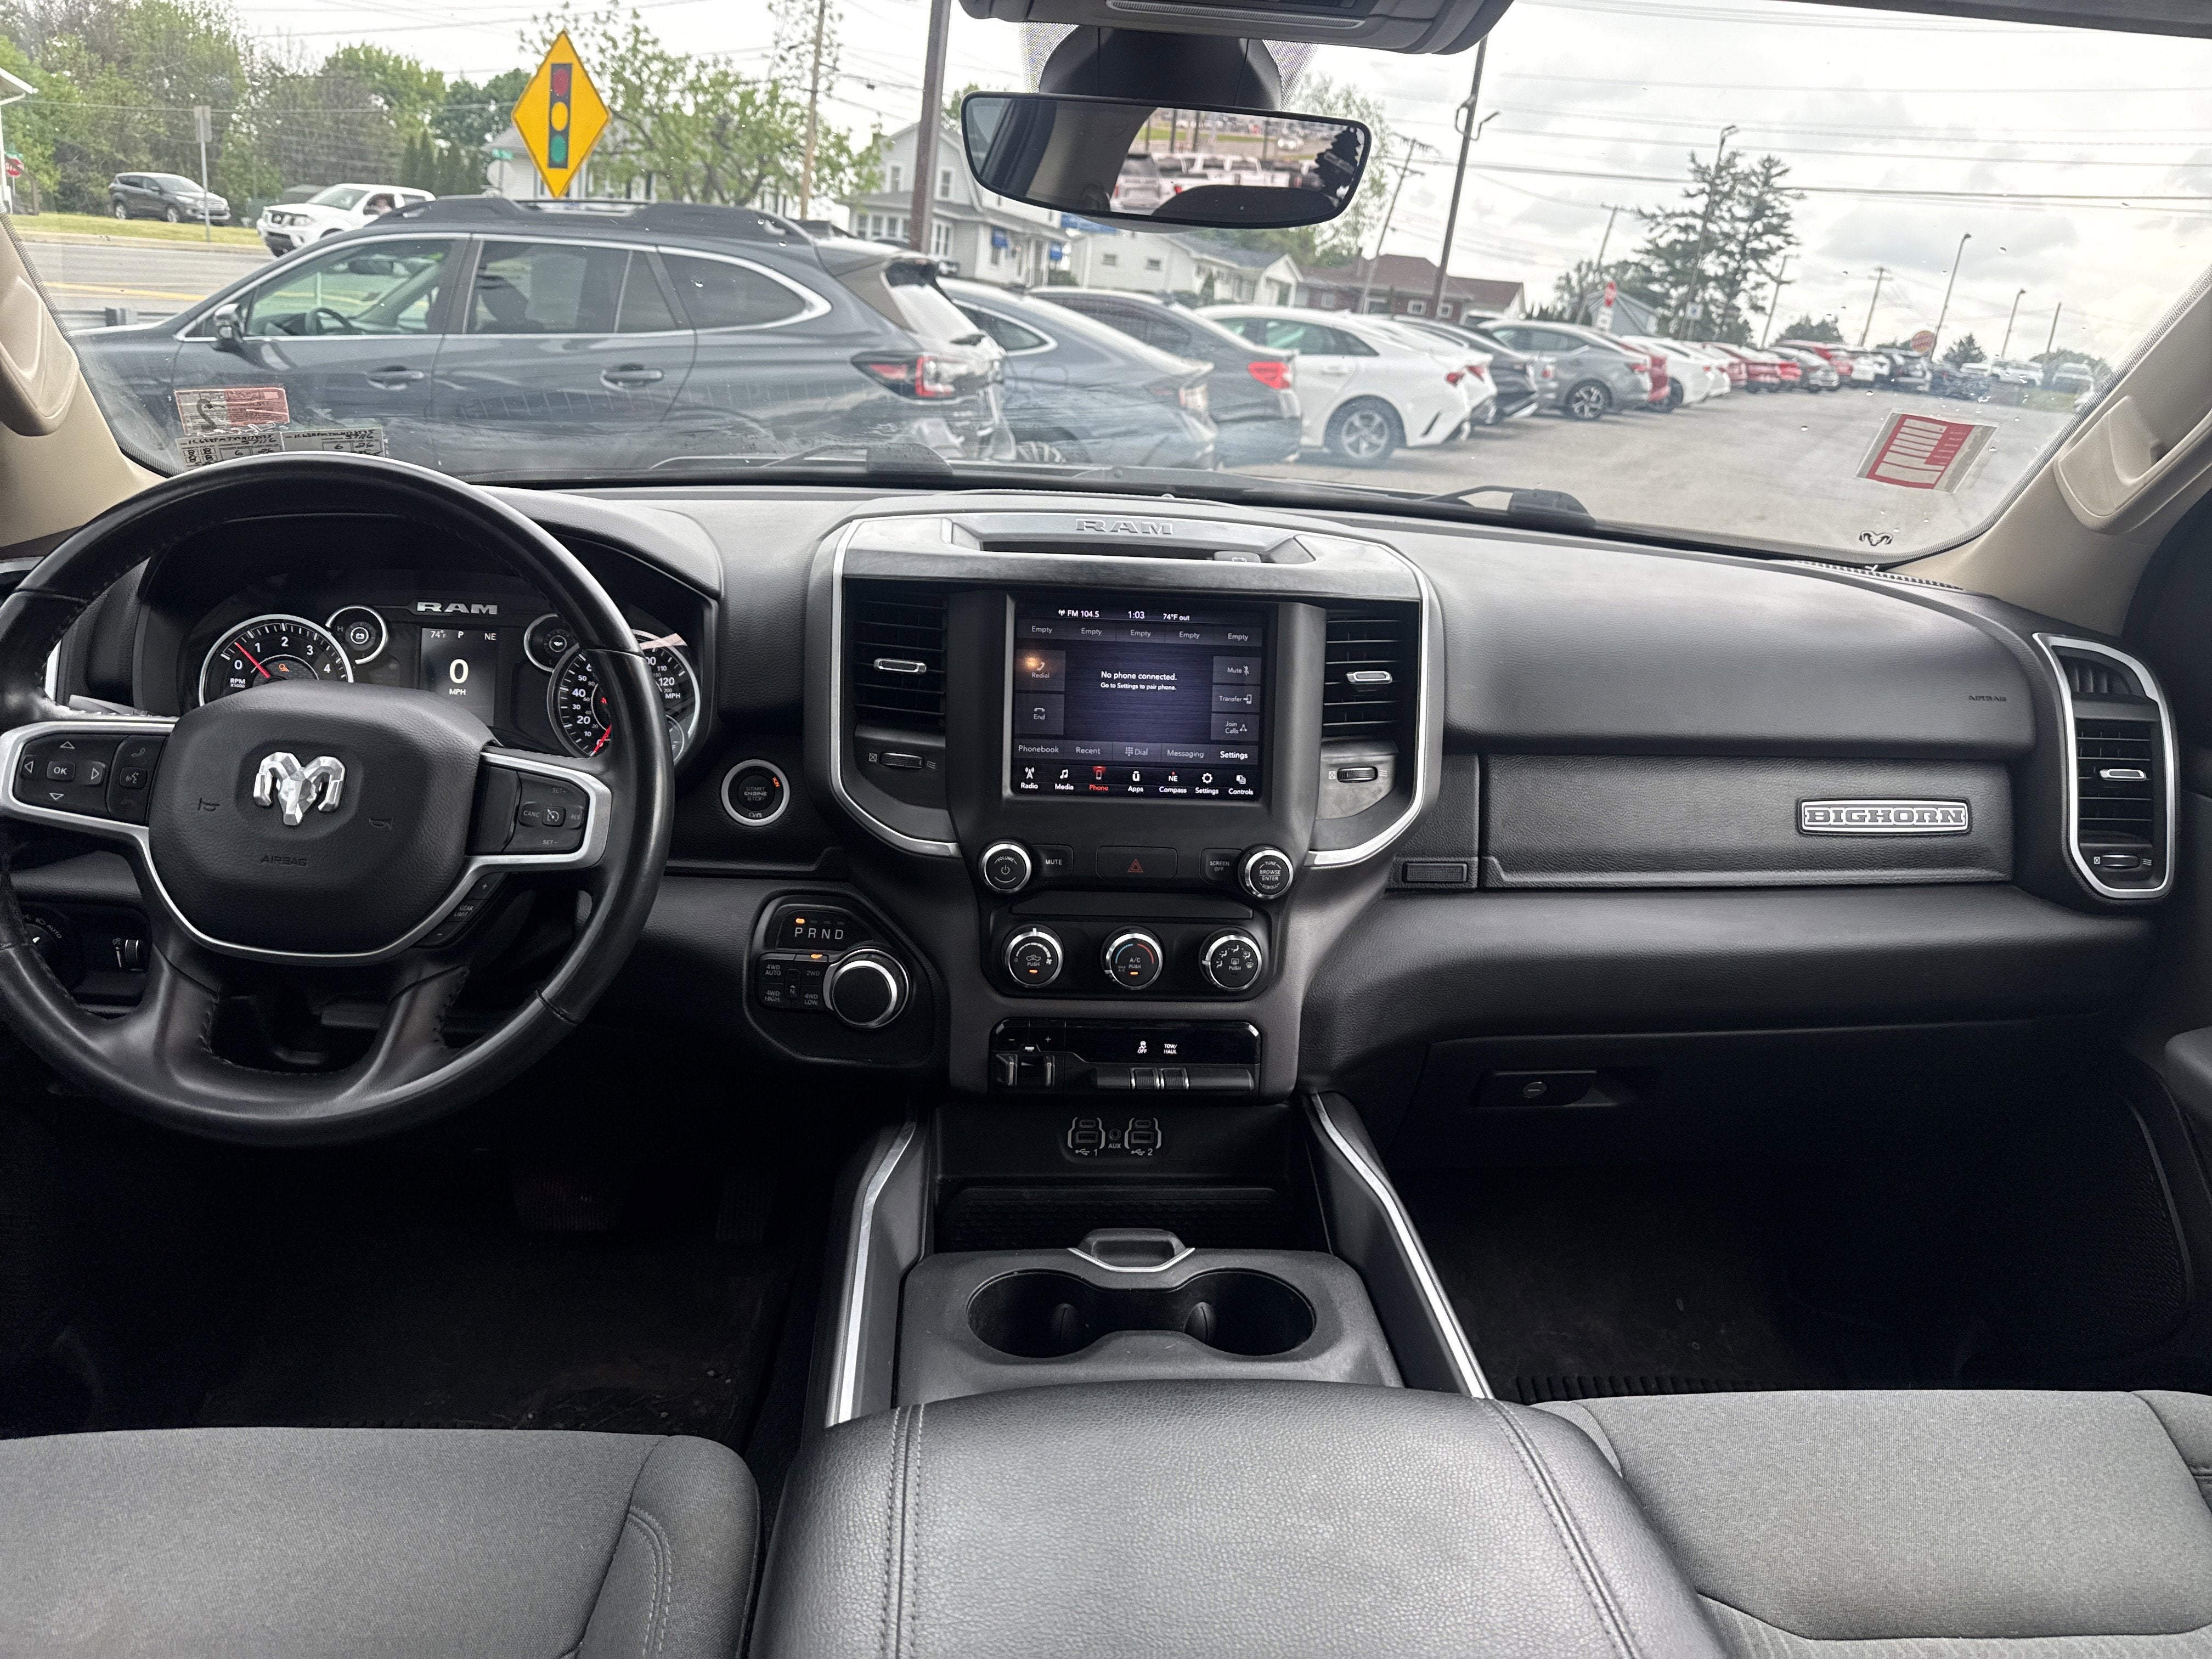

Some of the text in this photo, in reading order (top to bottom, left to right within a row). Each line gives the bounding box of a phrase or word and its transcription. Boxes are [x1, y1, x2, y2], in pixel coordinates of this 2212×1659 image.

[1076, 519, 1172, 535] RAM
[417, 602, 498, 614] RAM
[1031, 626, 1053, 635] Empty
[1081, 628, 1102, 636] Empty
[1130, 630, 1151, 638] Empty
[1179, 631, 1200, 640] Empty
[1228, 633, 1249, 641] Empty
[281, 636, 289, 647] 2
[255, 642, 261, 652] 1
[307, 645, 313, 655] 3
[234, 659, 242, 670] 0
[324, 663, 331, 673] 4
[449, 659, 469, 684] 0
[658, 677, 675, 686] 120
[572, 688, 586, 697] 40
[577, 715, 591, 724] 20
[1167, 749, 1204, 758] Messaging
[1220, 751, 1248, 760] Settings
[54, 766, 67, 775] OK
[1805, 808, 1966, 825] BIGHORN
[261, 855, 307, 866] AIRBAG
[47, 924, 61, 939] AUTO
